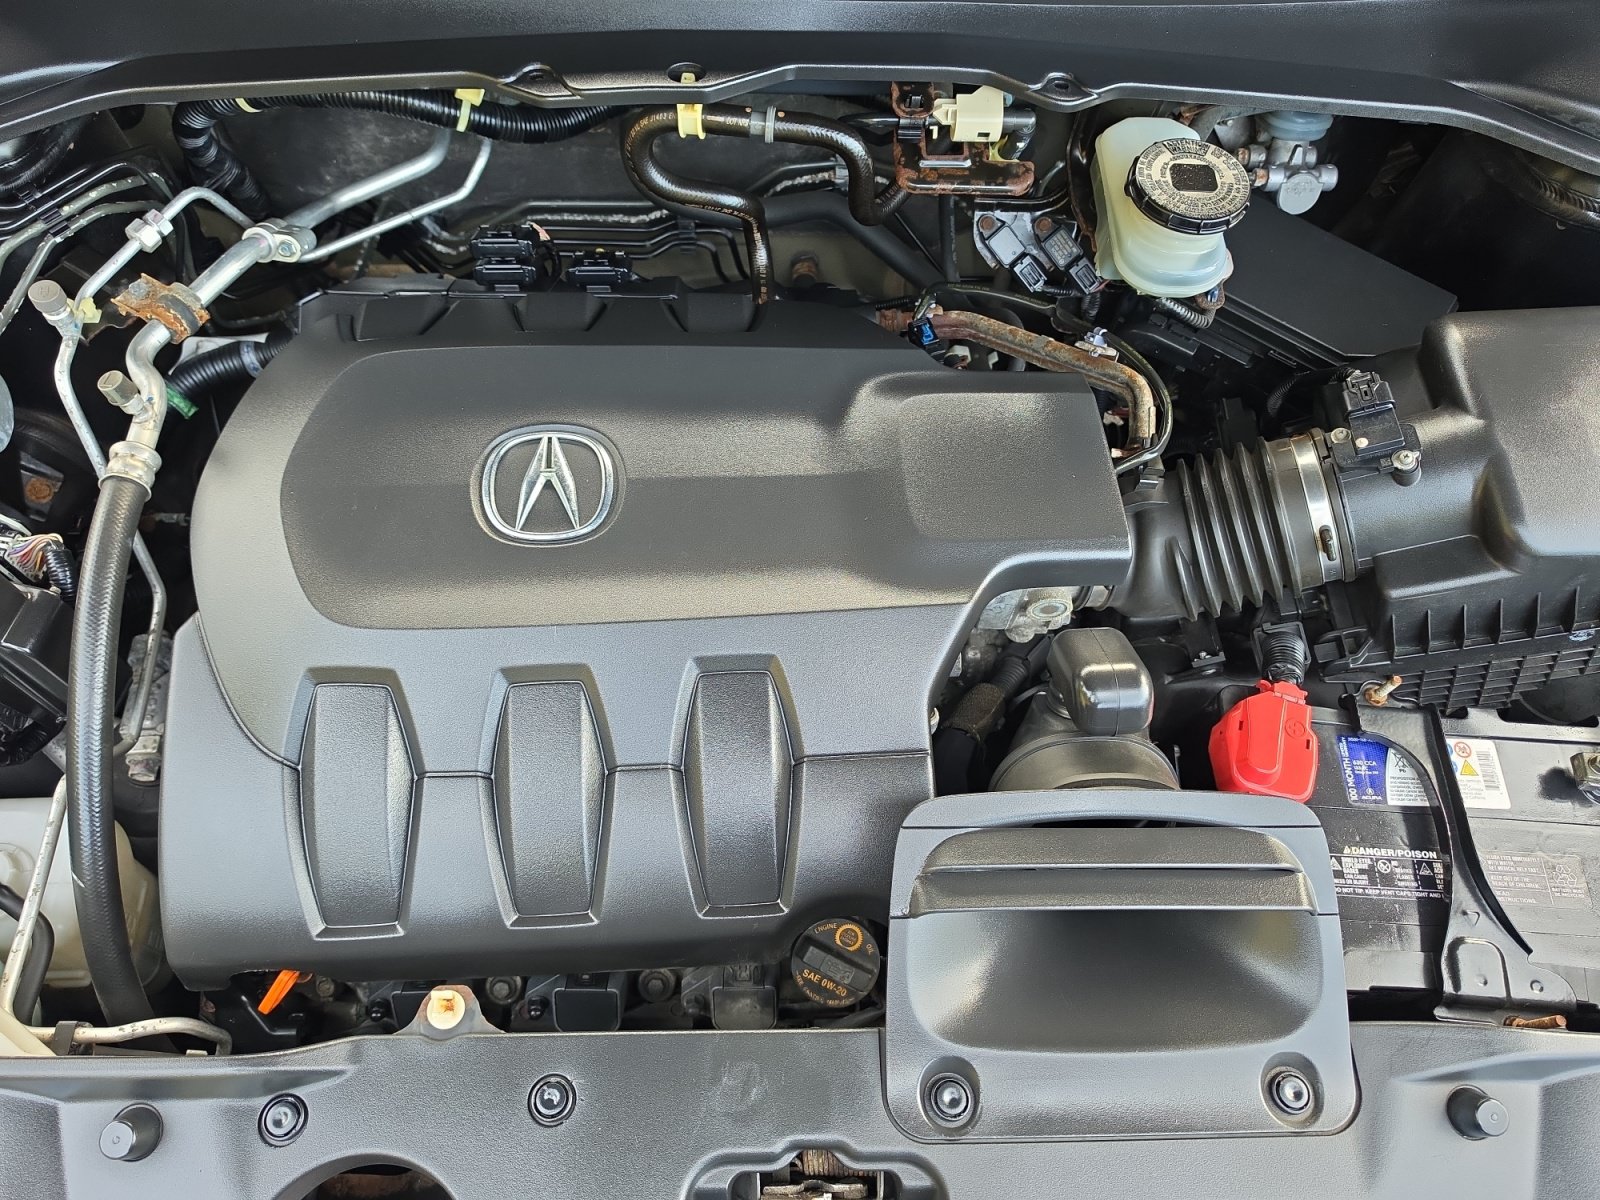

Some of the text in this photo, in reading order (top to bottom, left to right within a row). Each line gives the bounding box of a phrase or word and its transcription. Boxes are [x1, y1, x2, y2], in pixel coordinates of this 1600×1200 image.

[1166, 140, 1210, 152] ATTENTION
[1171, 147, 1206, 156] WARNING
[1342, 758, 1358, 800] 100 MONTH
[1351, 846, 1438, 859] DANGER/POISON
[814, 922, 838, 934] ENGINE
[866, 944, 874, 955] OIL
[802, 969, 848, 997] SAE 0W-20
